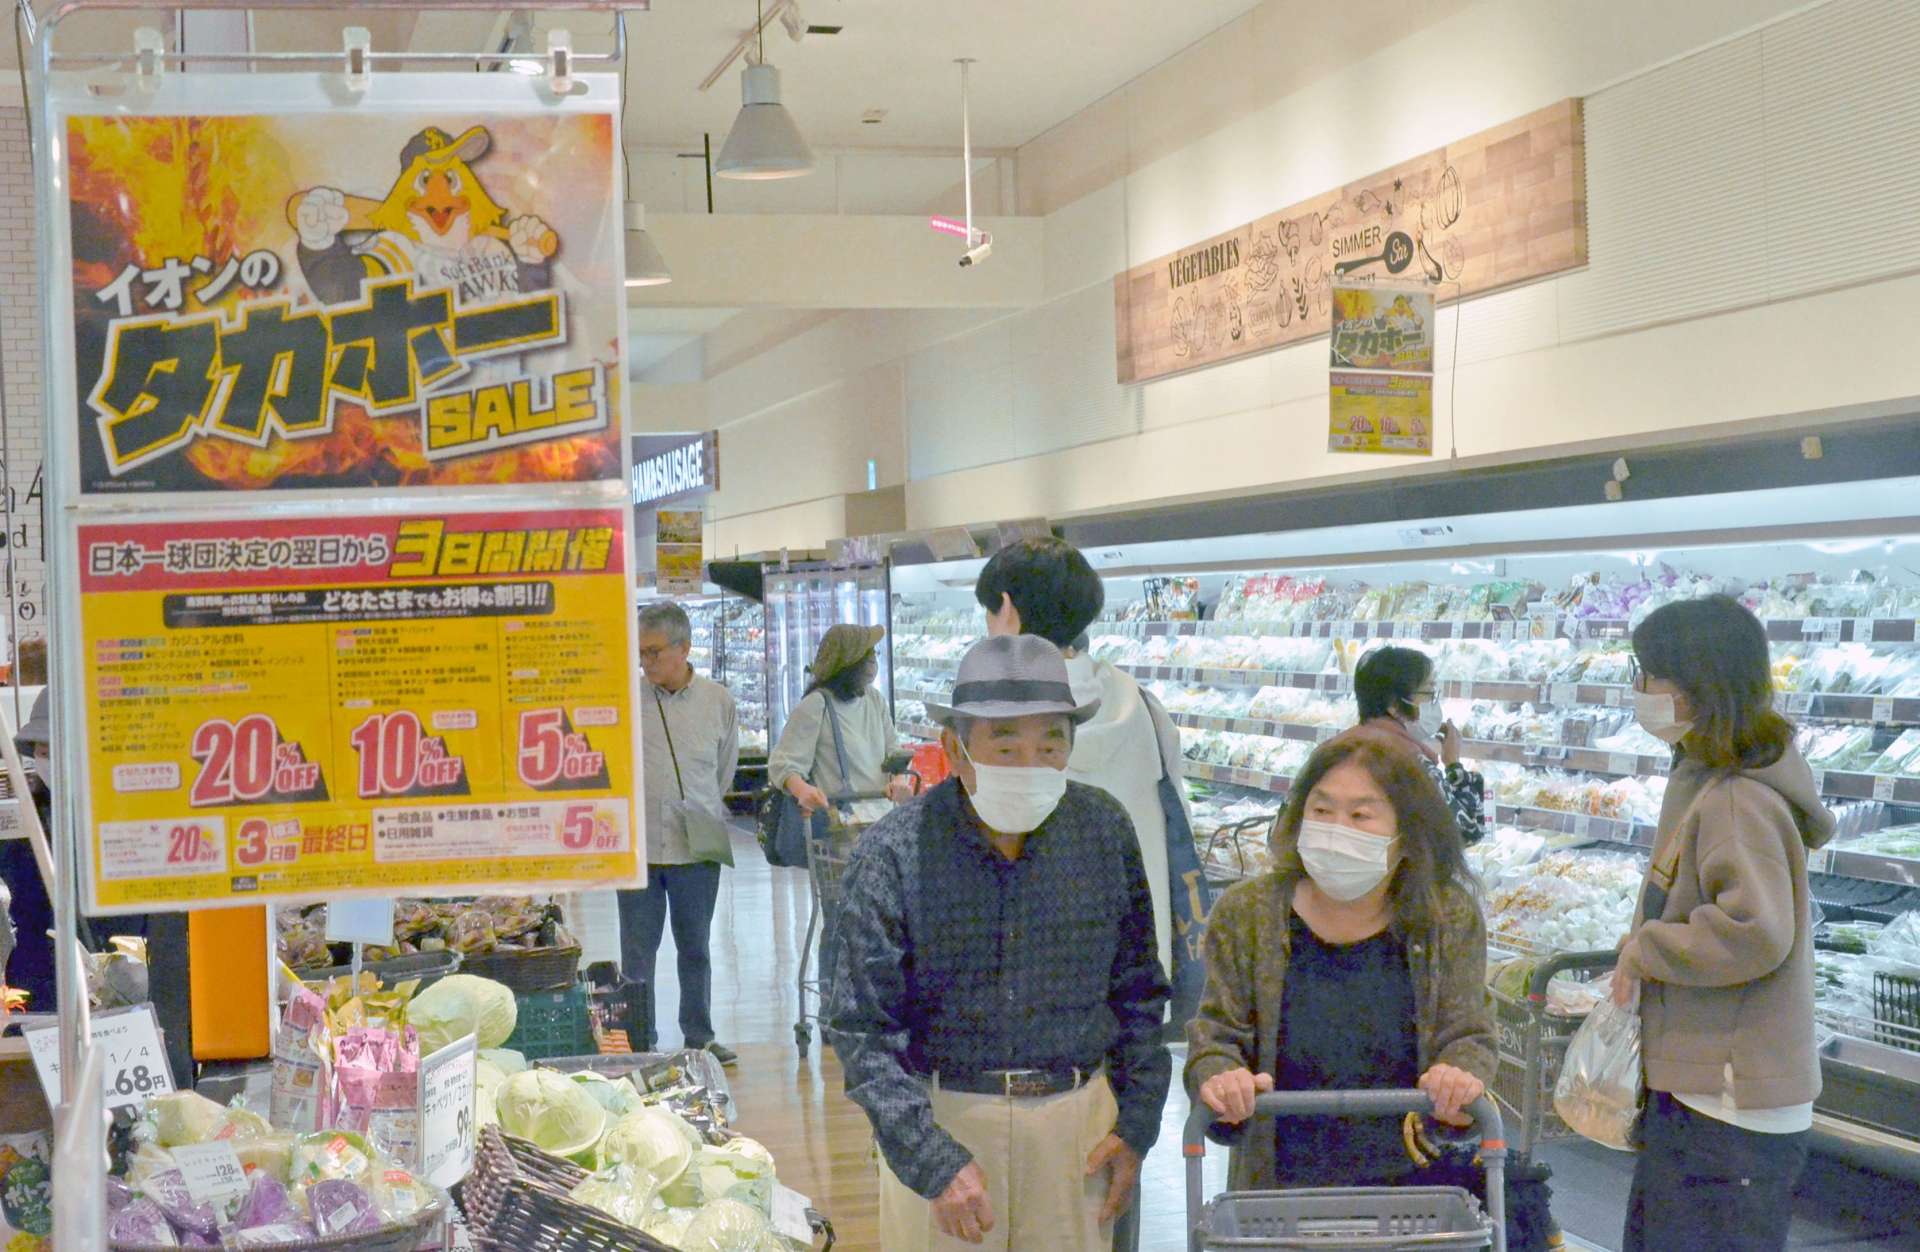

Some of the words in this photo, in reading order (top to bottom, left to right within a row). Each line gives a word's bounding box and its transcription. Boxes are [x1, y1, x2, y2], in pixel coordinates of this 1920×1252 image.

[1333, 226, 1382, 258] SIMMER
[1168, 237, 1241, 289] VEGETABLES
[96, 250, 280, 316] イオンの
[92, 280, 565, 472] タカホー
[427, 366, 598, 451] SALE
[89, 534, 389, 576] 日本一球団決定の翌日から
[275, 762, 320, 793] OFF
[420, 756, 461, 787] OFF
[565, 752, 604, 780] OFF
[303, 824, 368, 854] 最終日
